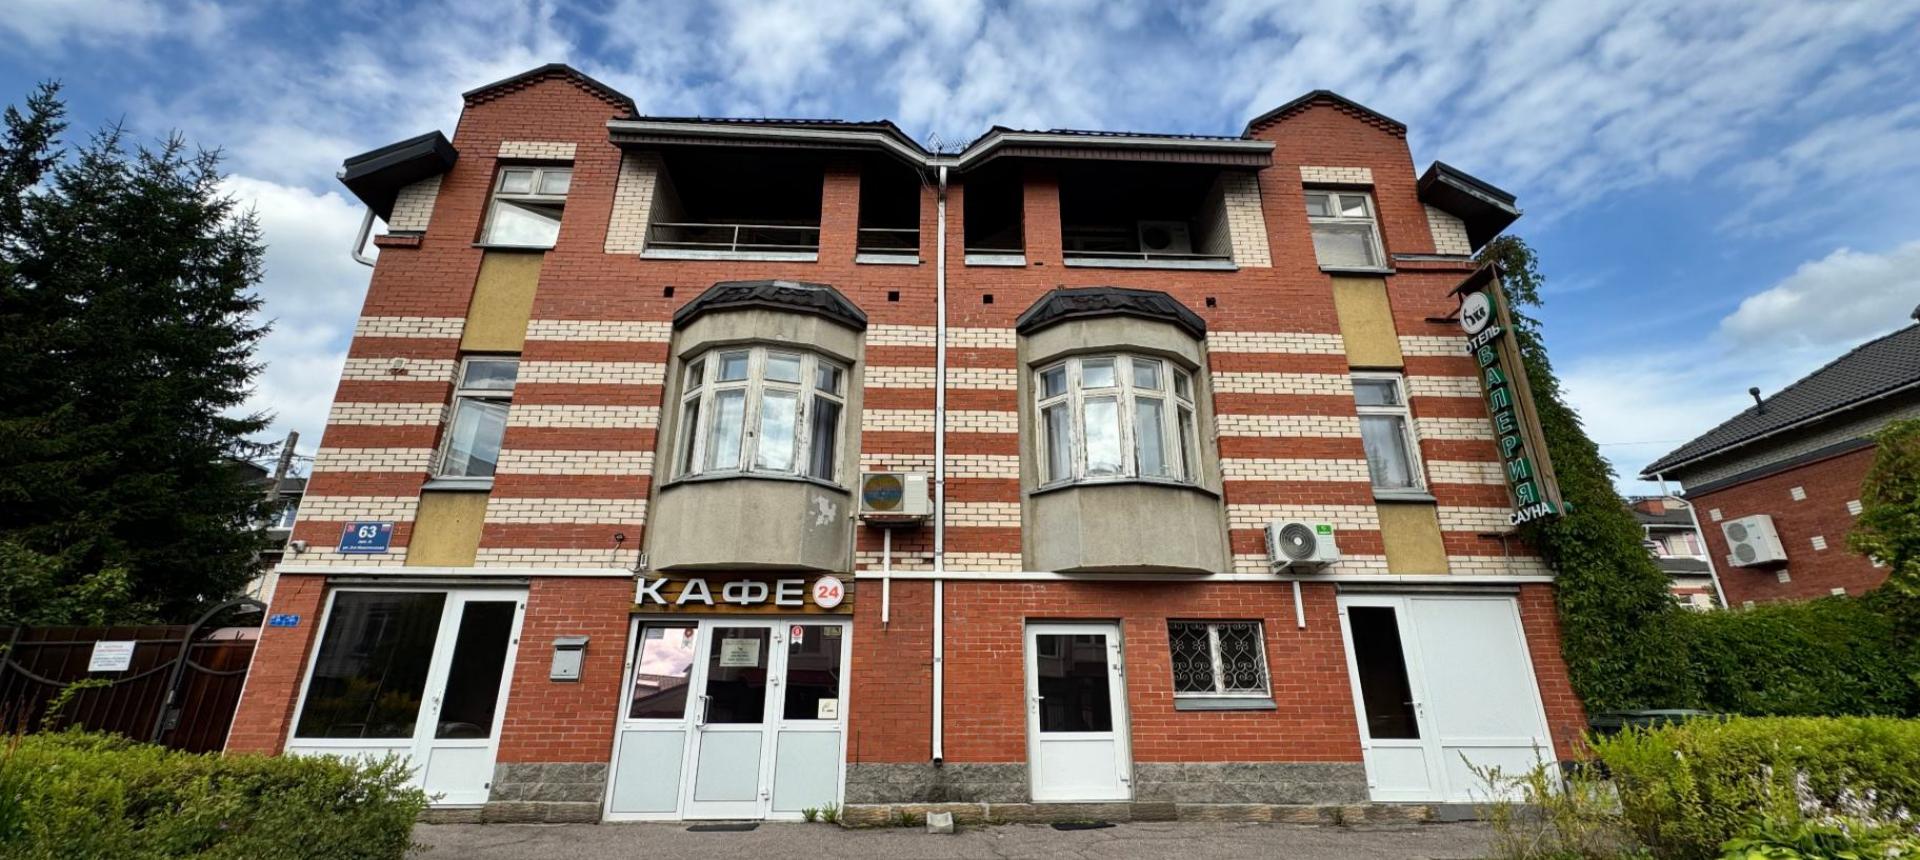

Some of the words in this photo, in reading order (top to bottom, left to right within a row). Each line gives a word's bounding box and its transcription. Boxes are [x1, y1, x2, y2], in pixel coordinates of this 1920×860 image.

[1465, 325, 1501, 353] ОТЕЛЬ
[1477, 345, 1534, 507] ВАЛЕРИЯ
[1509, 501, 1551, 526] САУНА
[358, 525, 377, 538] 63
[635, 578, 804, 605] КАФЕ
[819, 586, 839, 599] 24
